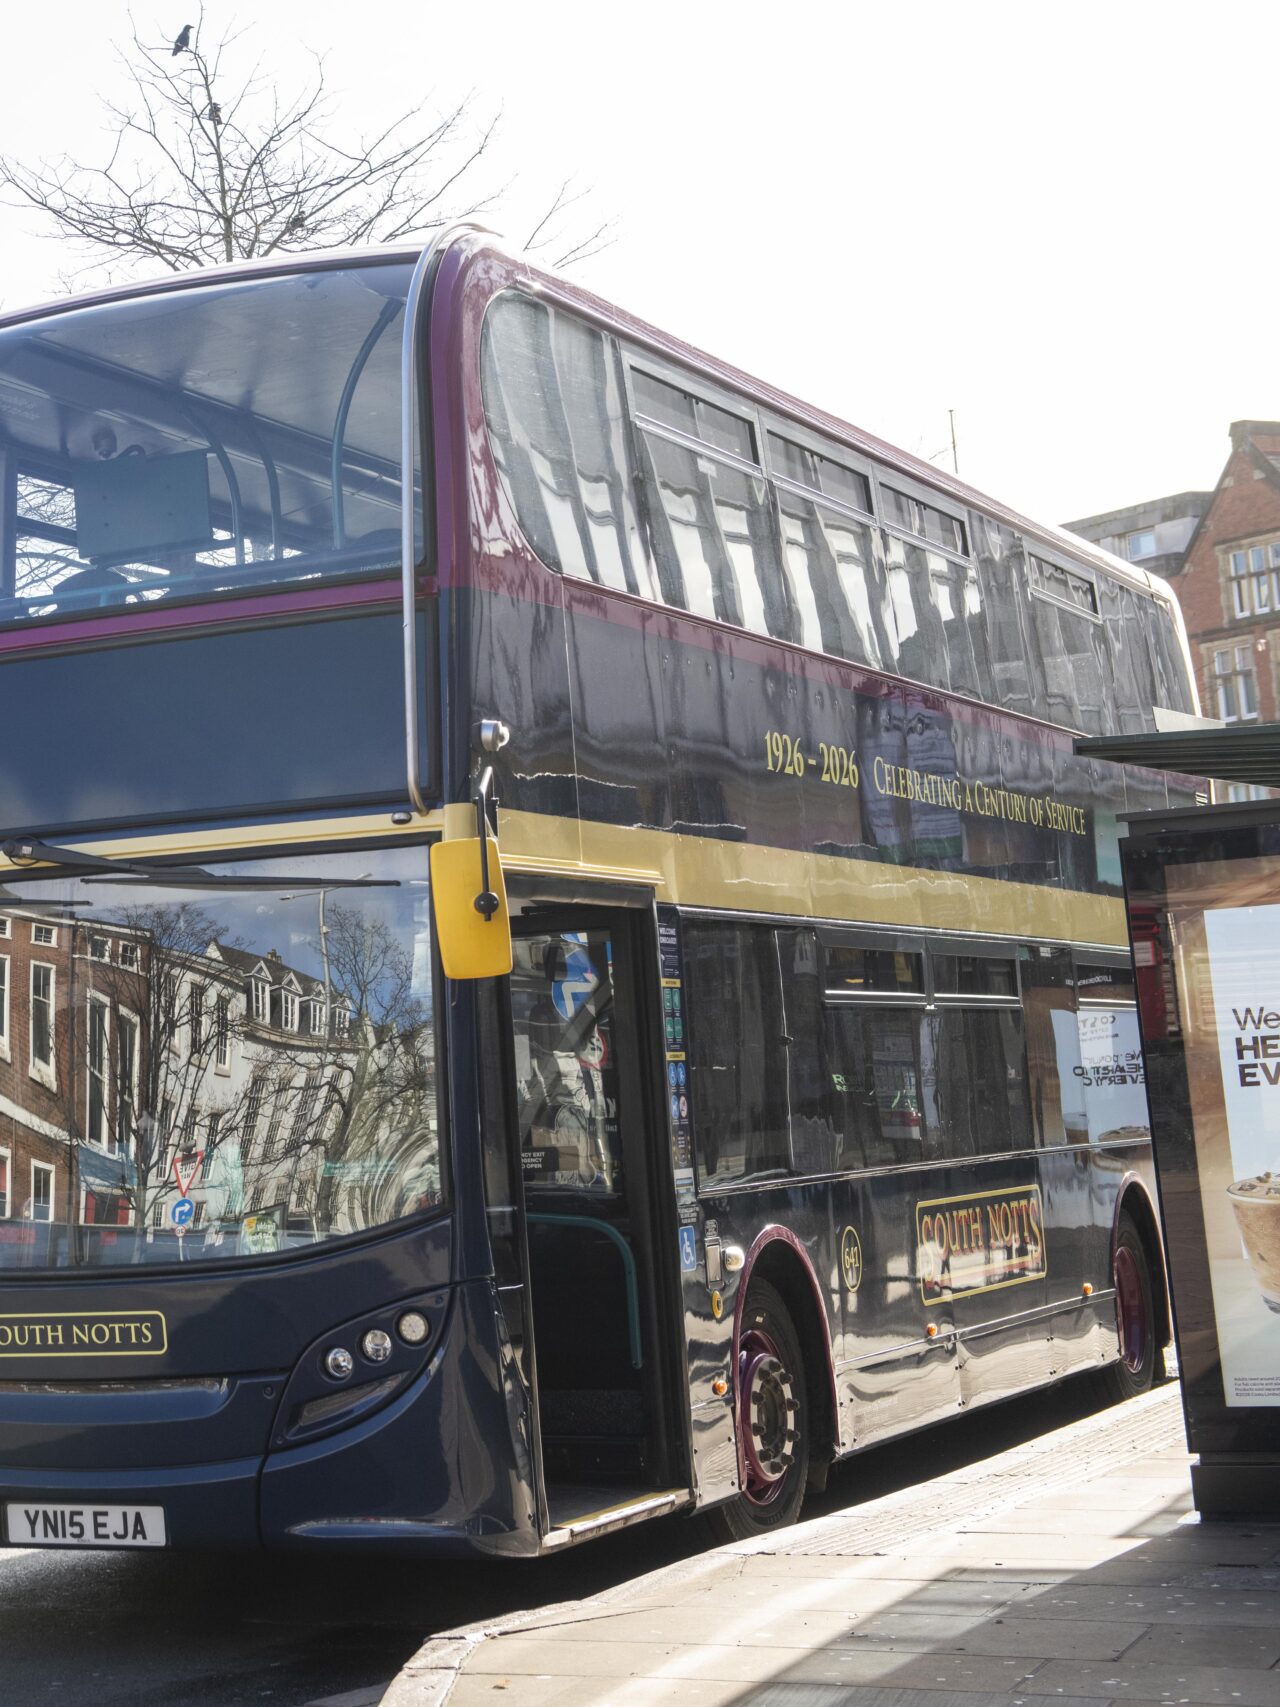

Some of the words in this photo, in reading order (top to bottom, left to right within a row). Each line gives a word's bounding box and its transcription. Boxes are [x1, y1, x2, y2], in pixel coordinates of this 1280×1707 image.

[765, 730, 804, 777] 1926
[819, 742, 859, 788] 2026
[845, 1246, 860, 1269] 641
[922, 1206, 984, 1288] SOUTH
[987, 1197, 1043, 1264] NOTTS
[72, 1322, 153, 1345] NOTTS
[24, 1509, 85, 1539] YN15
[92, 1510, 148, 1540] EJA
